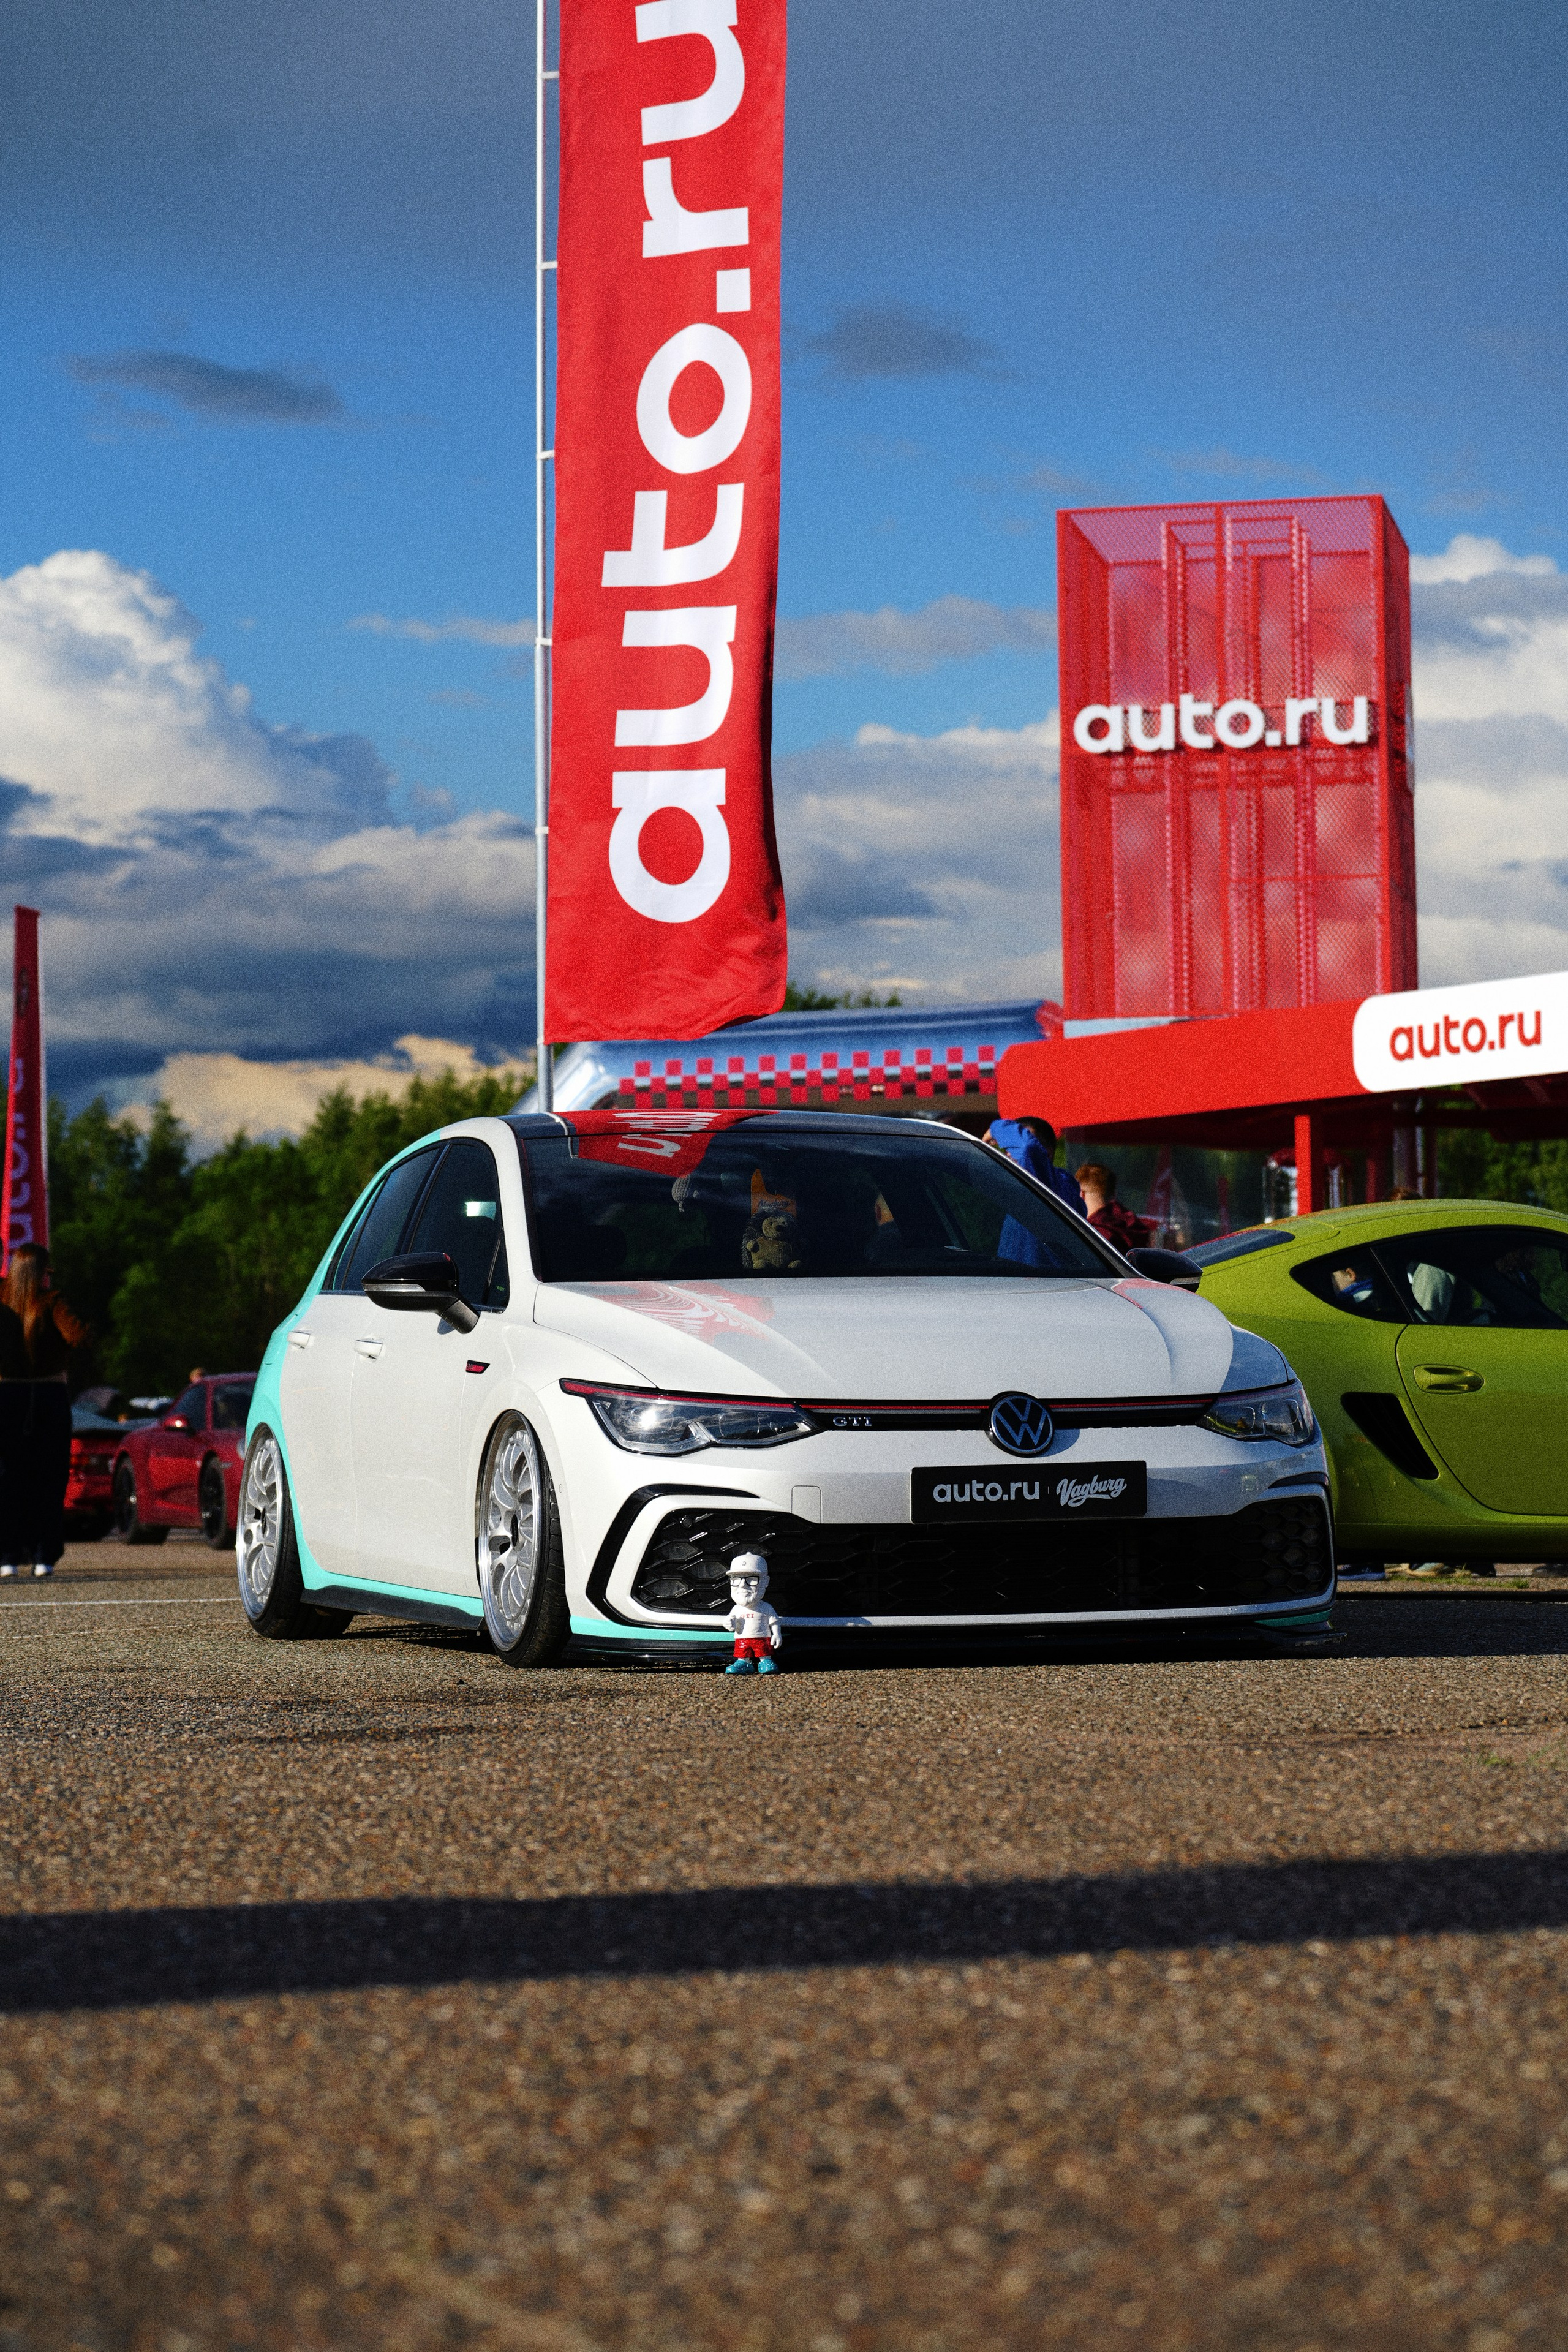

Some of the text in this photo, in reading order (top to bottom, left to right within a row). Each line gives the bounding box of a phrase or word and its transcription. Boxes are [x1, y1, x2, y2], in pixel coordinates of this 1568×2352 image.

[601, 0, 752, 923] auto.ru
[1073, 693, 1369, 753] auto.ru
[1390, 1010, 1542, 1061] auto.ru
[832, 1417, 872, 1427] GTI
[933, 1474, 1128, 1507] auto.ru Vagburg
